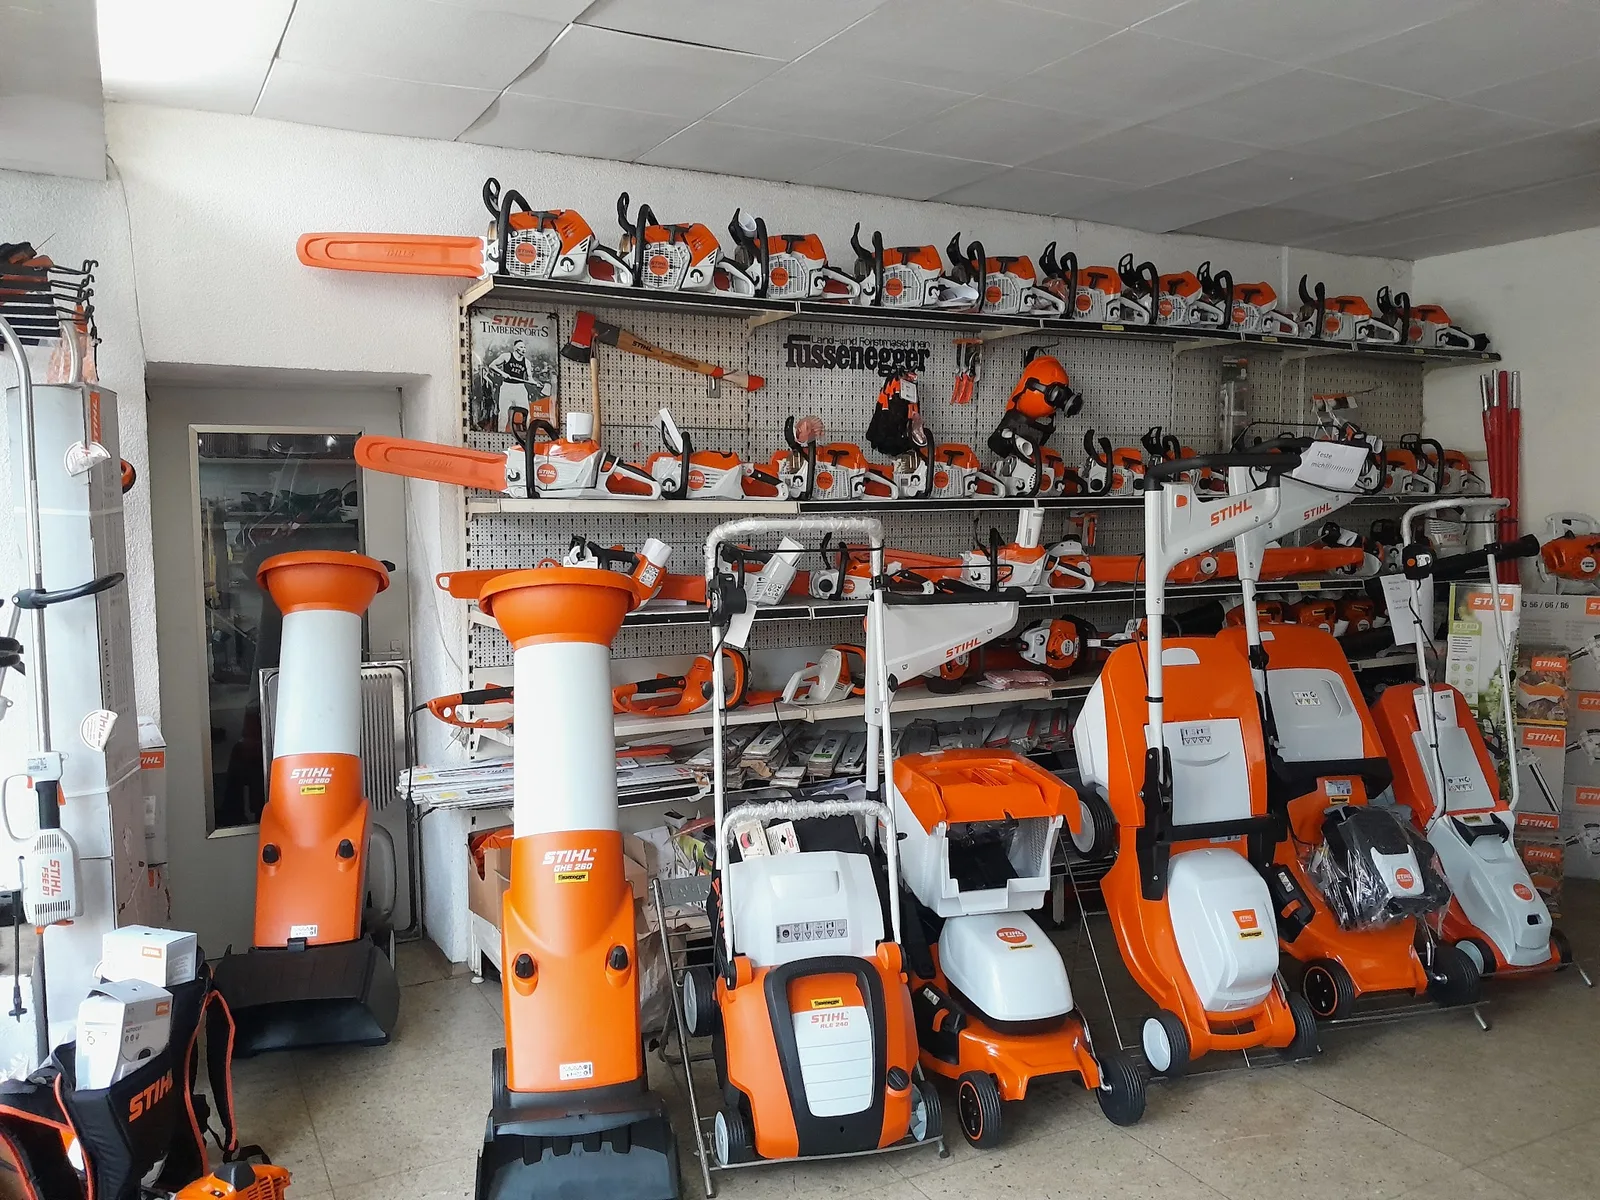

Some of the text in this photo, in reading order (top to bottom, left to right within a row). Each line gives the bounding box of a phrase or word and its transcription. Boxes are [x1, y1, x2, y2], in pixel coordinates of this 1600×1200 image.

[491, 314, 539, 328] STIHL
[480, 320, 549, 338] TIMBERSPORTS
[631, 340, 653, 352] STIHL
[783, 334, 931, 377] fussenegger
[1316, 450, 1333, 459] Teste
[1210, 499, 1253, 527] STIHL
[1303, 502, 1332, 521] STIHL
[945, 637, 982, 659] STIHL
[1535, 660, 1563, 668] STIHL
[1581, 697, 1600, 705] STI
[1526, 732, 1561, 742] STIHL
[290, 767, 332, 779] STIHL
[1520, 818, 1555, 829] STIHL
[542, 848, 595, 865] STIHL
[1527, 850, 1556, 859] STIHL
[574, 862, 593, 870] 260
[41, 866, 50, 885] FSE
[49, 859, 62, 897] STIHL
[811, 1012, 849, 1024] STIHL
